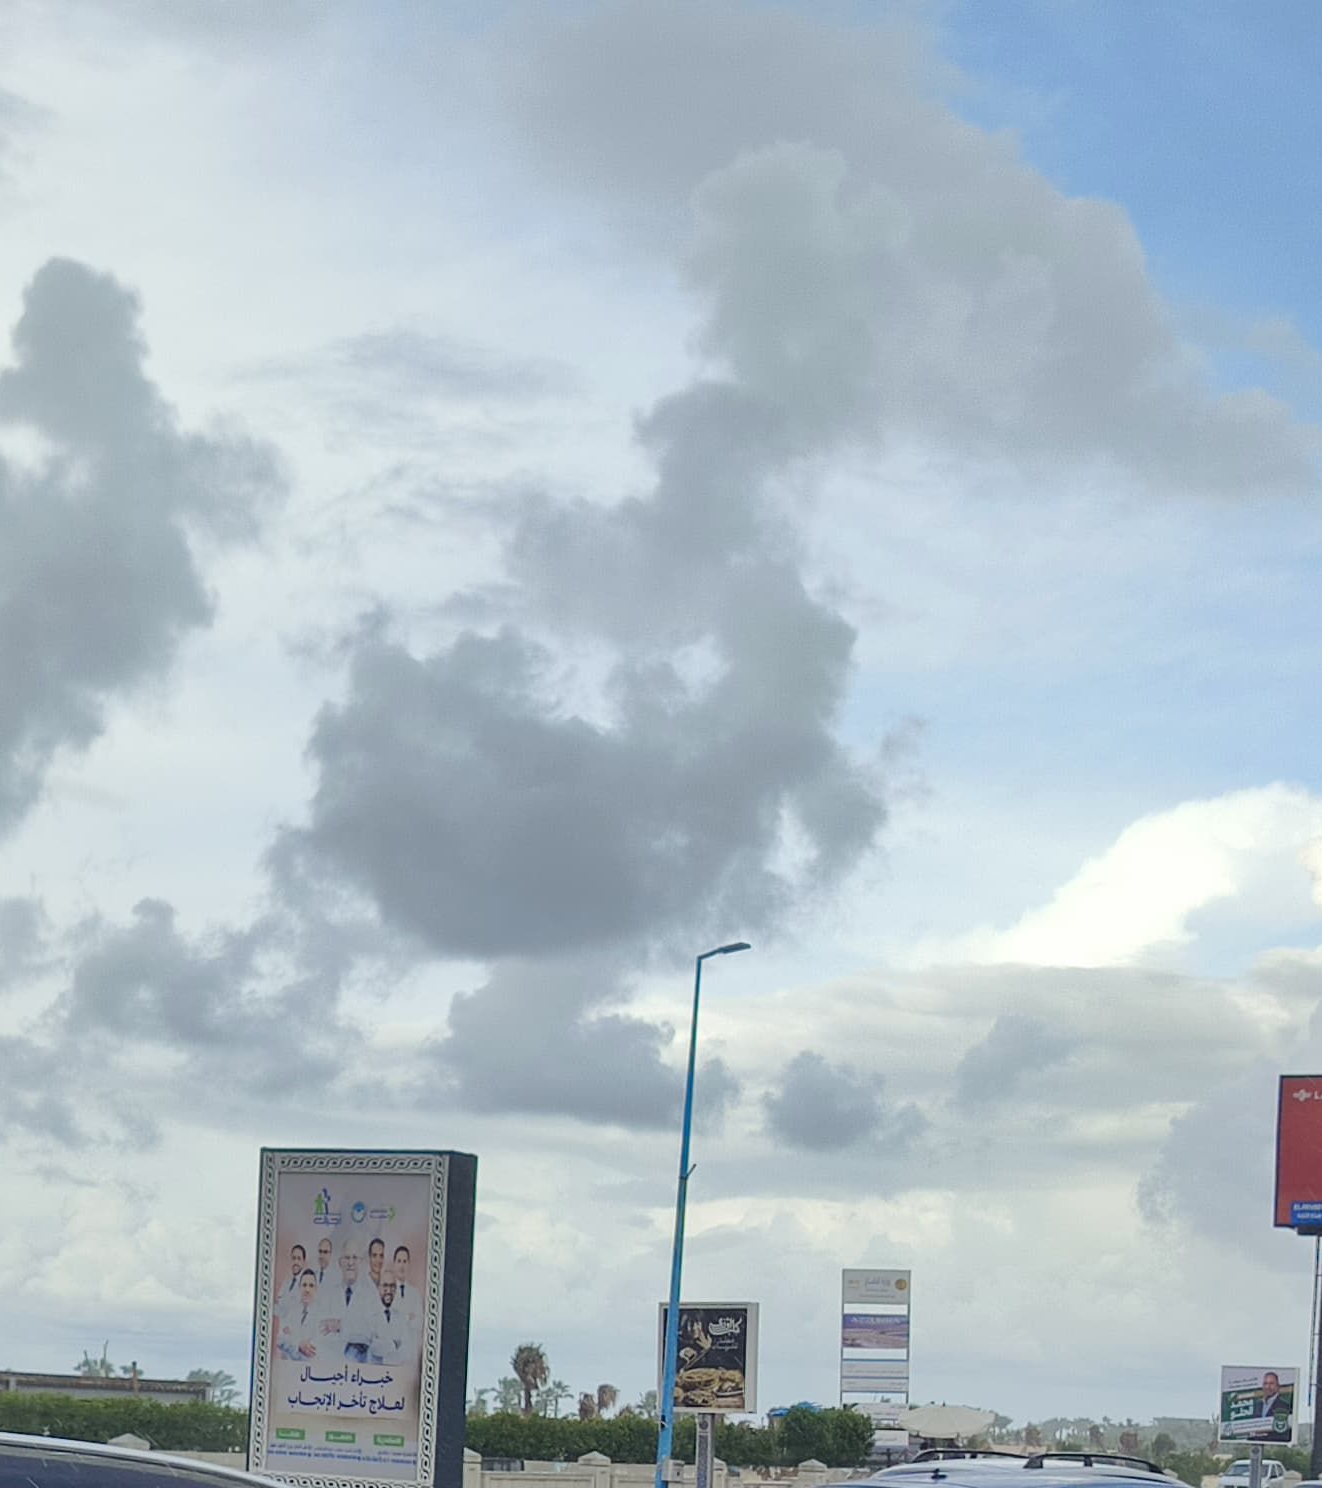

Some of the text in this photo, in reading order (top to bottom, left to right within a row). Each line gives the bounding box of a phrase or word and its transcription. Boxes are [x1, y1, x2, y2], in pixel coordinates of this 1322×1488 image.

[300, 1364, 394, 1388] خبراء أجيال
[287, 1391, 406, 1415] لعلاج تأخر الإنجاب
